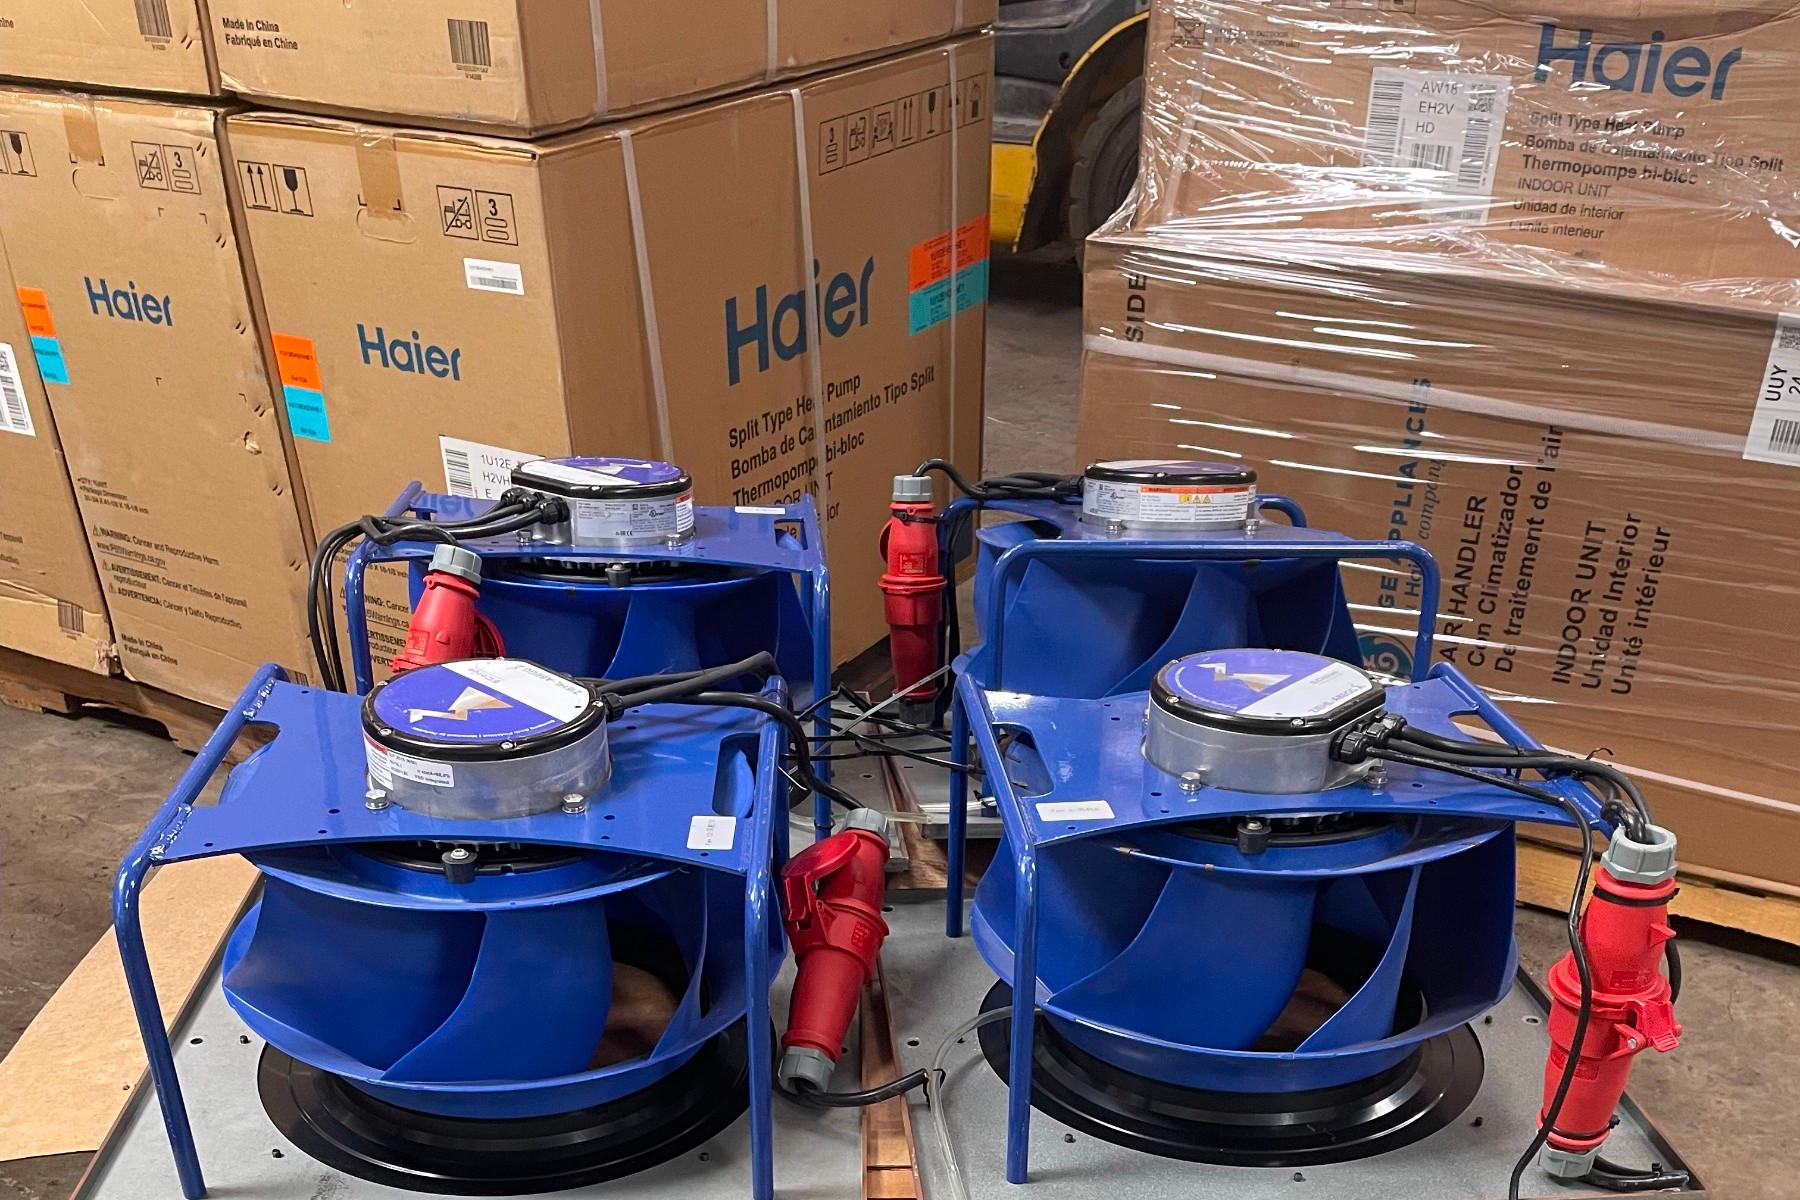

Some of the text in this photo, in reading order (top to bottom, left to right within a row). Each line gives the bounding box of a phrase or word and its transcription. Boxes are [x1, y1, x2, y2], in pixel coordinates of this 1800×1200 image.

[222, 17, 245, 30] Made
[256, 20, 280, 32] China
[263, 39, 273, 48] en
[274, 38, 298, 50] Chine
[1535, 22, 1743, 101] Haier
[1415, 121, 1435, 134] HD
[1418, 101, 1455, 115] EH2V
[1568, 114, 1600, 131] Type
[1522, 154, 1638, 180] Thermopompe
[1525, 134, 1575, 153] Bomba
[1579, 141, 1597, 153] de
[1749, 155, 1784, 173] Split
[1513, 199, 1625, 221] Unidad de interior
[1517, 177, 1611, 198] INDOOR UNIT
[84, 276, 173, 326] Haier
[1125, 273, 1147, 342] SIDE
[356, 323, 461, 381] Haier
[1765, 364, 1788, 402] UUY
[729, 418, 759, 449] Split
[762, 406, 793, 434] Type
[827, 374, 861, 402] Pump
[731, 365, 934, 480] Bomba de Cantamiento Tipo Split
[825, 431, 865, 464] bi-bloc
[482, 471, 511, 486] H2VH
[1378, 377, 1431, 609] GE PPLIANCES
[1448, 495, 1488, 617] HANDLER
[1467, 464, 1524, 667] Con Climatizador
[1494, 426, 1564, 673] De traitement de l'air
[1552, 520, 1606, 684] INDOOR UNIT
[1581, 512, 1641, 689] Unidad Interior
[1610, 526, 1671, 695] Unité intérieur
